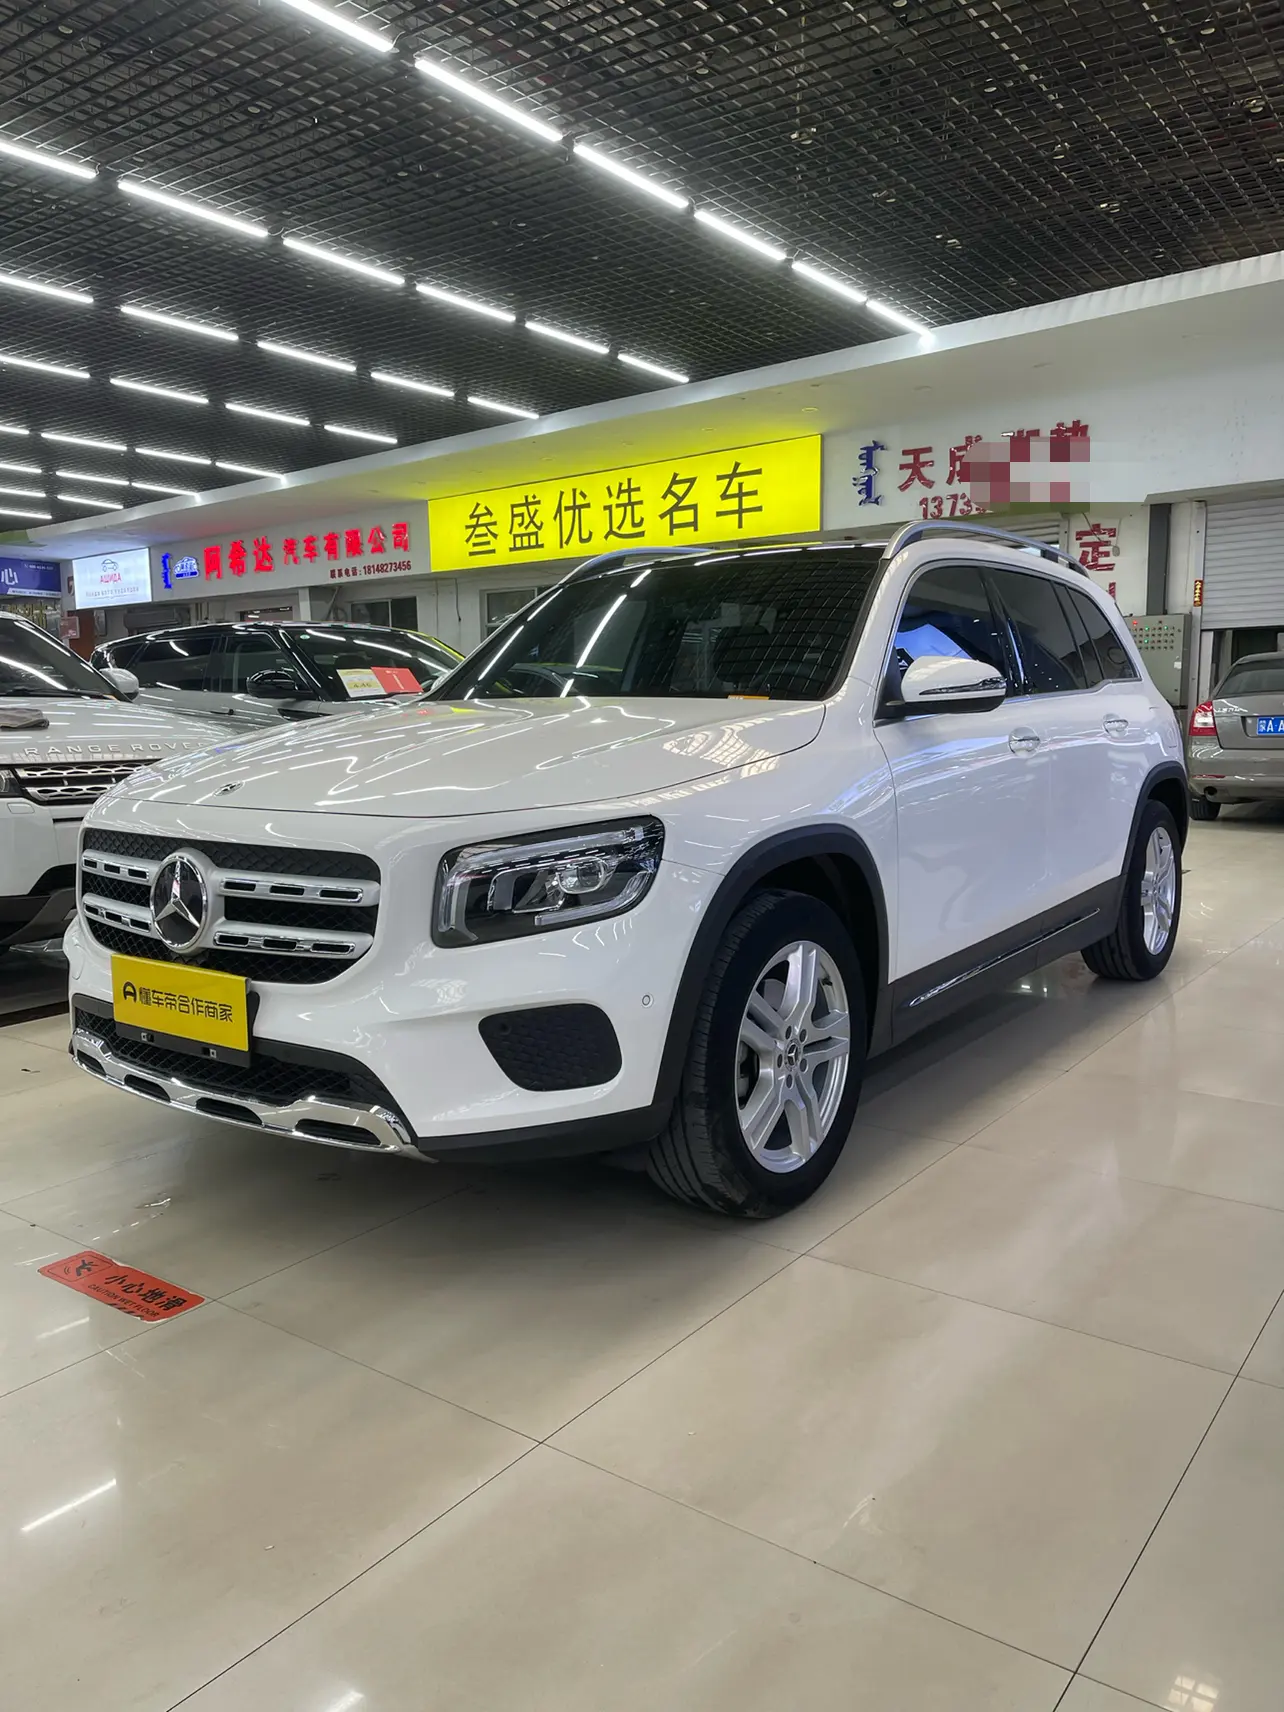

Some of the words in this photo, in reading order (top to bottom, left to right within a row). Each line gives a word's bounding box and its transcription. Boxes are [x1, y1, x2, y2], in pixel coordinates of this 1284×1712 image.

[465, 461, 763, 556] 叁盛优选名车
[204, 536, 274, 581] 阿希达
[282, 522, 410, 565] 汽车有限公司
[25, 744, 119, 755] RANGE
[139, 986, 233, 1023] 懂车帝合作商家
[88, 1283, 118, 1300] CAUTION
[118, 1297, 136, 1307] WET
[136, 1303, 160, 1317] FLOOR
[105, 1275, 187, 1311] 小心地滑
